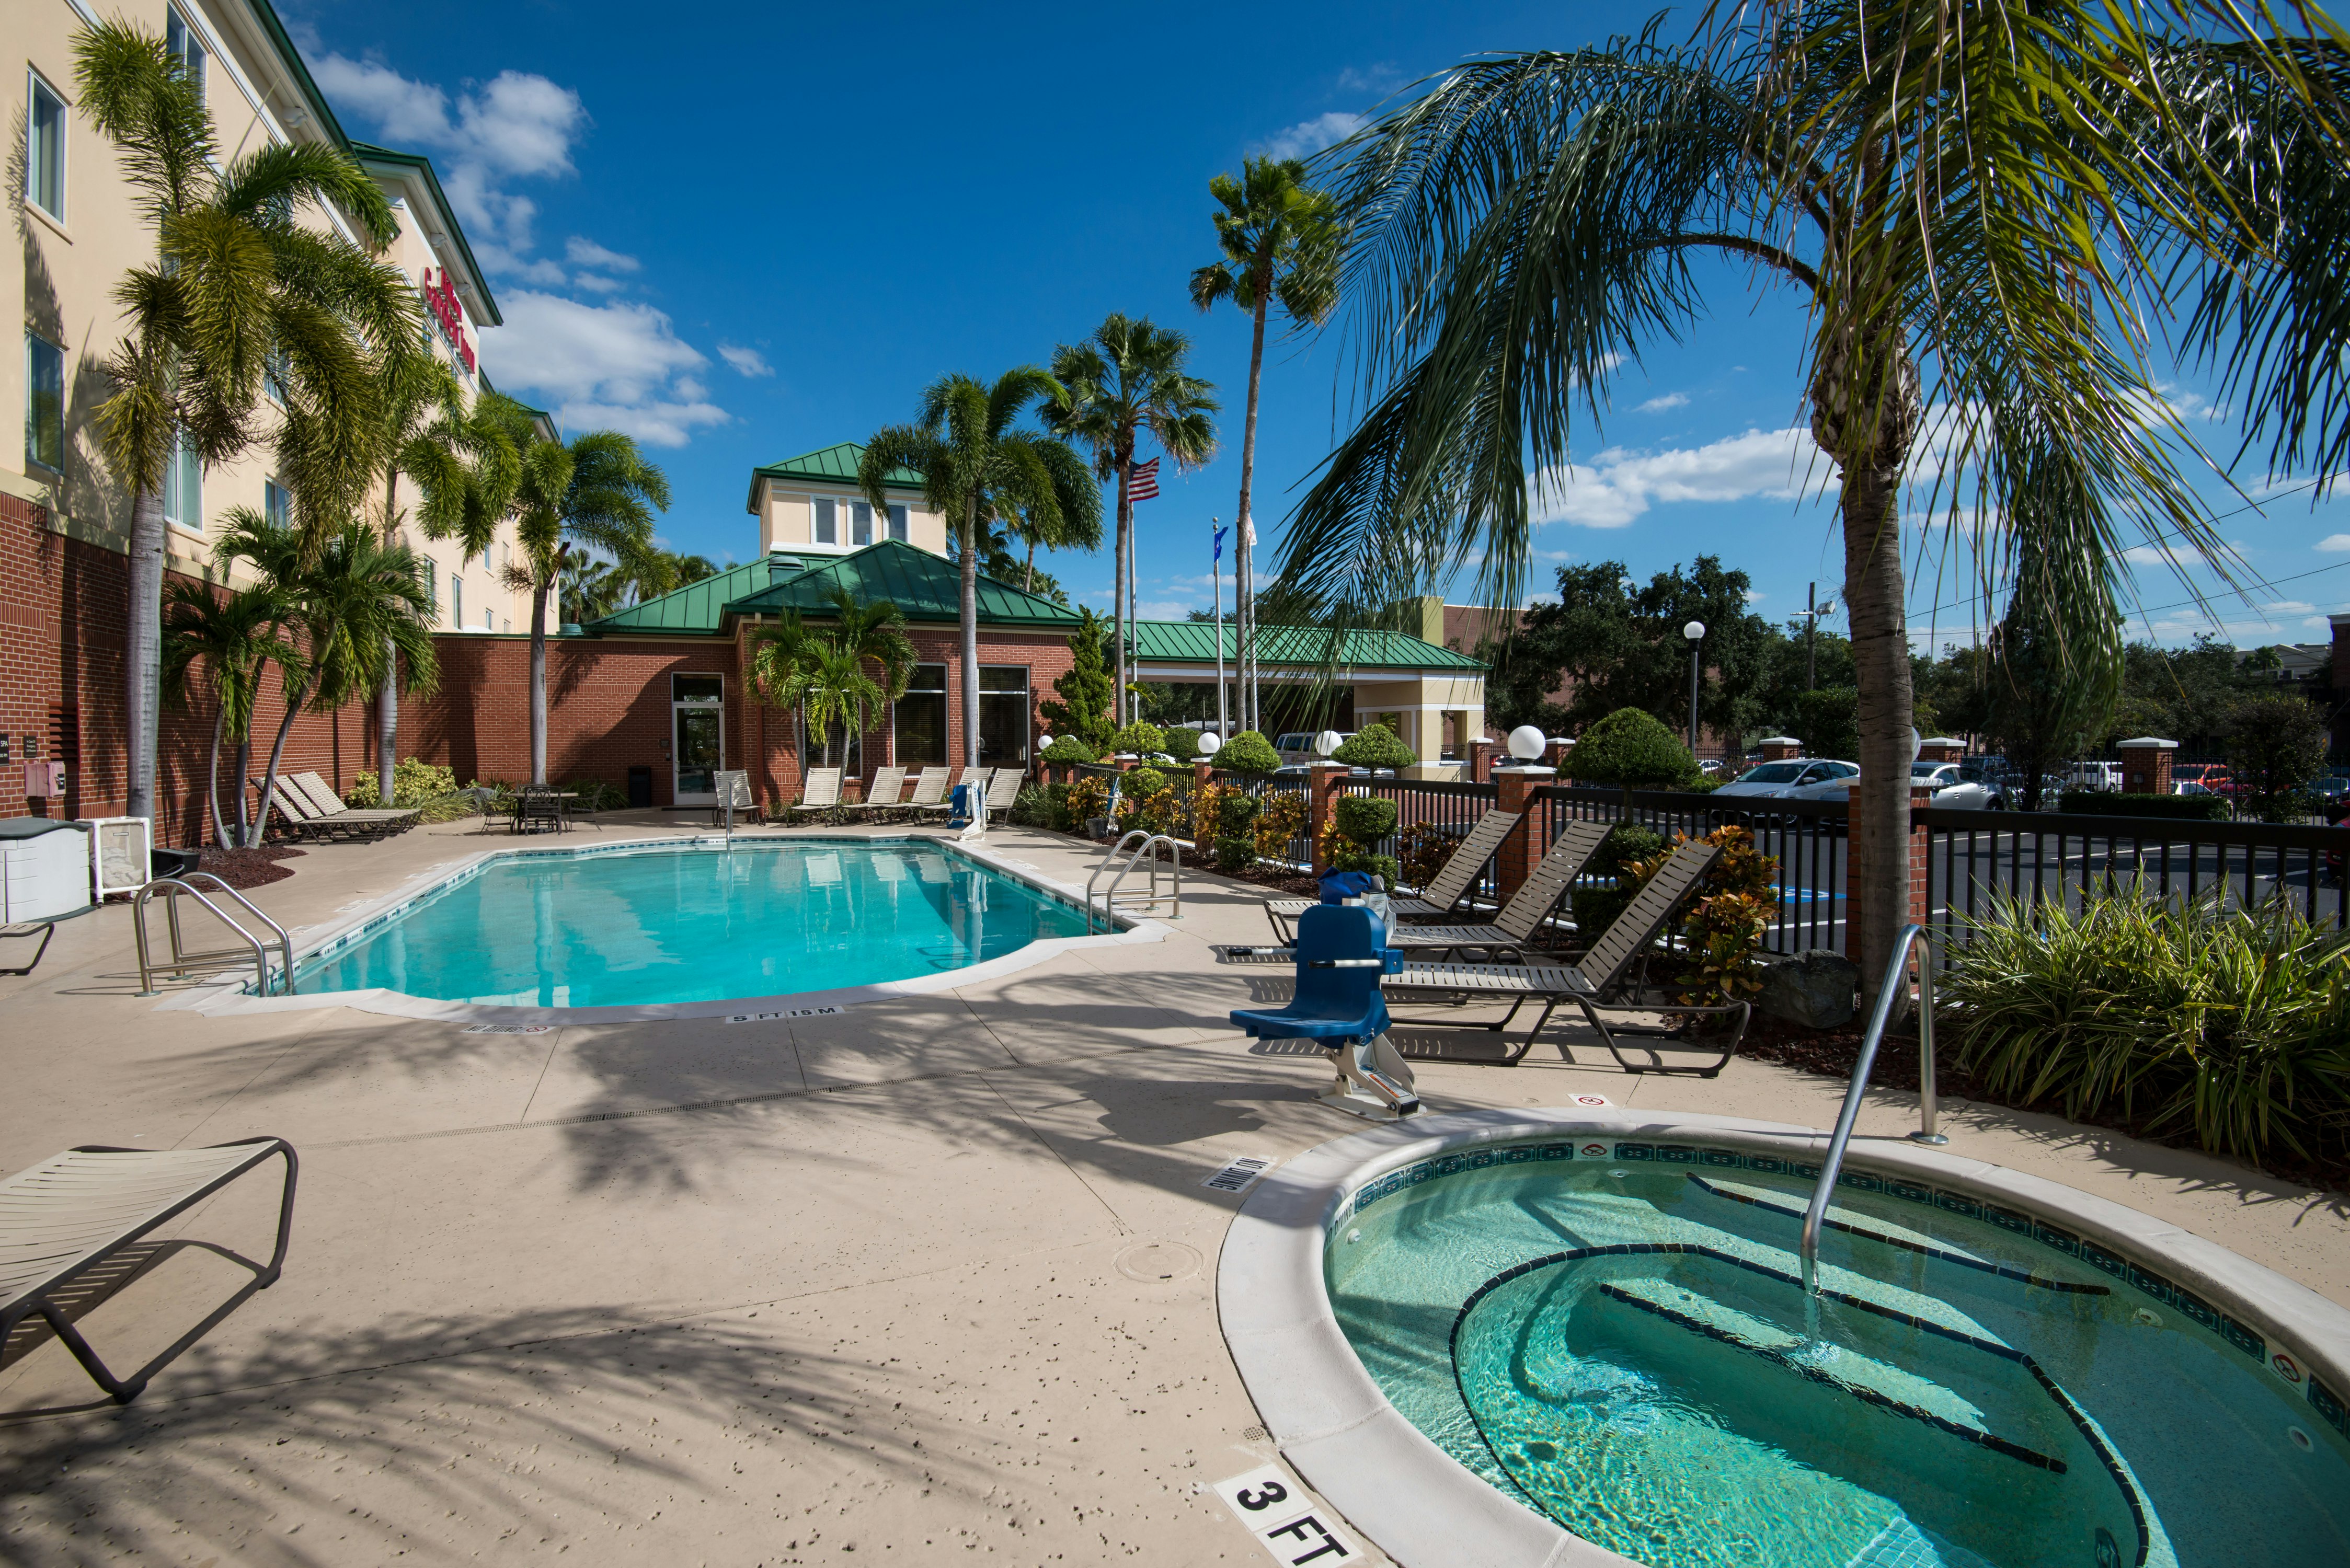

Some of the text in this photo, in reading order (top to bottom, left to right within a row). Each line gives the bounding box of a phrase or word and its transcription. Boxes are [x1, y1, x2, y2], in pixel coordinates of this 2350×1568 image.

[421, 267, 475, 374] Garden Inn
[1208, 1158, 1268, 1190] NO DIVING
[1325, 1203, 1352, 1249] NO DIVING
[2280, 1376, 2300, 1392] DIVING
[1237, 1481, 1349, 1566] 3 FT
